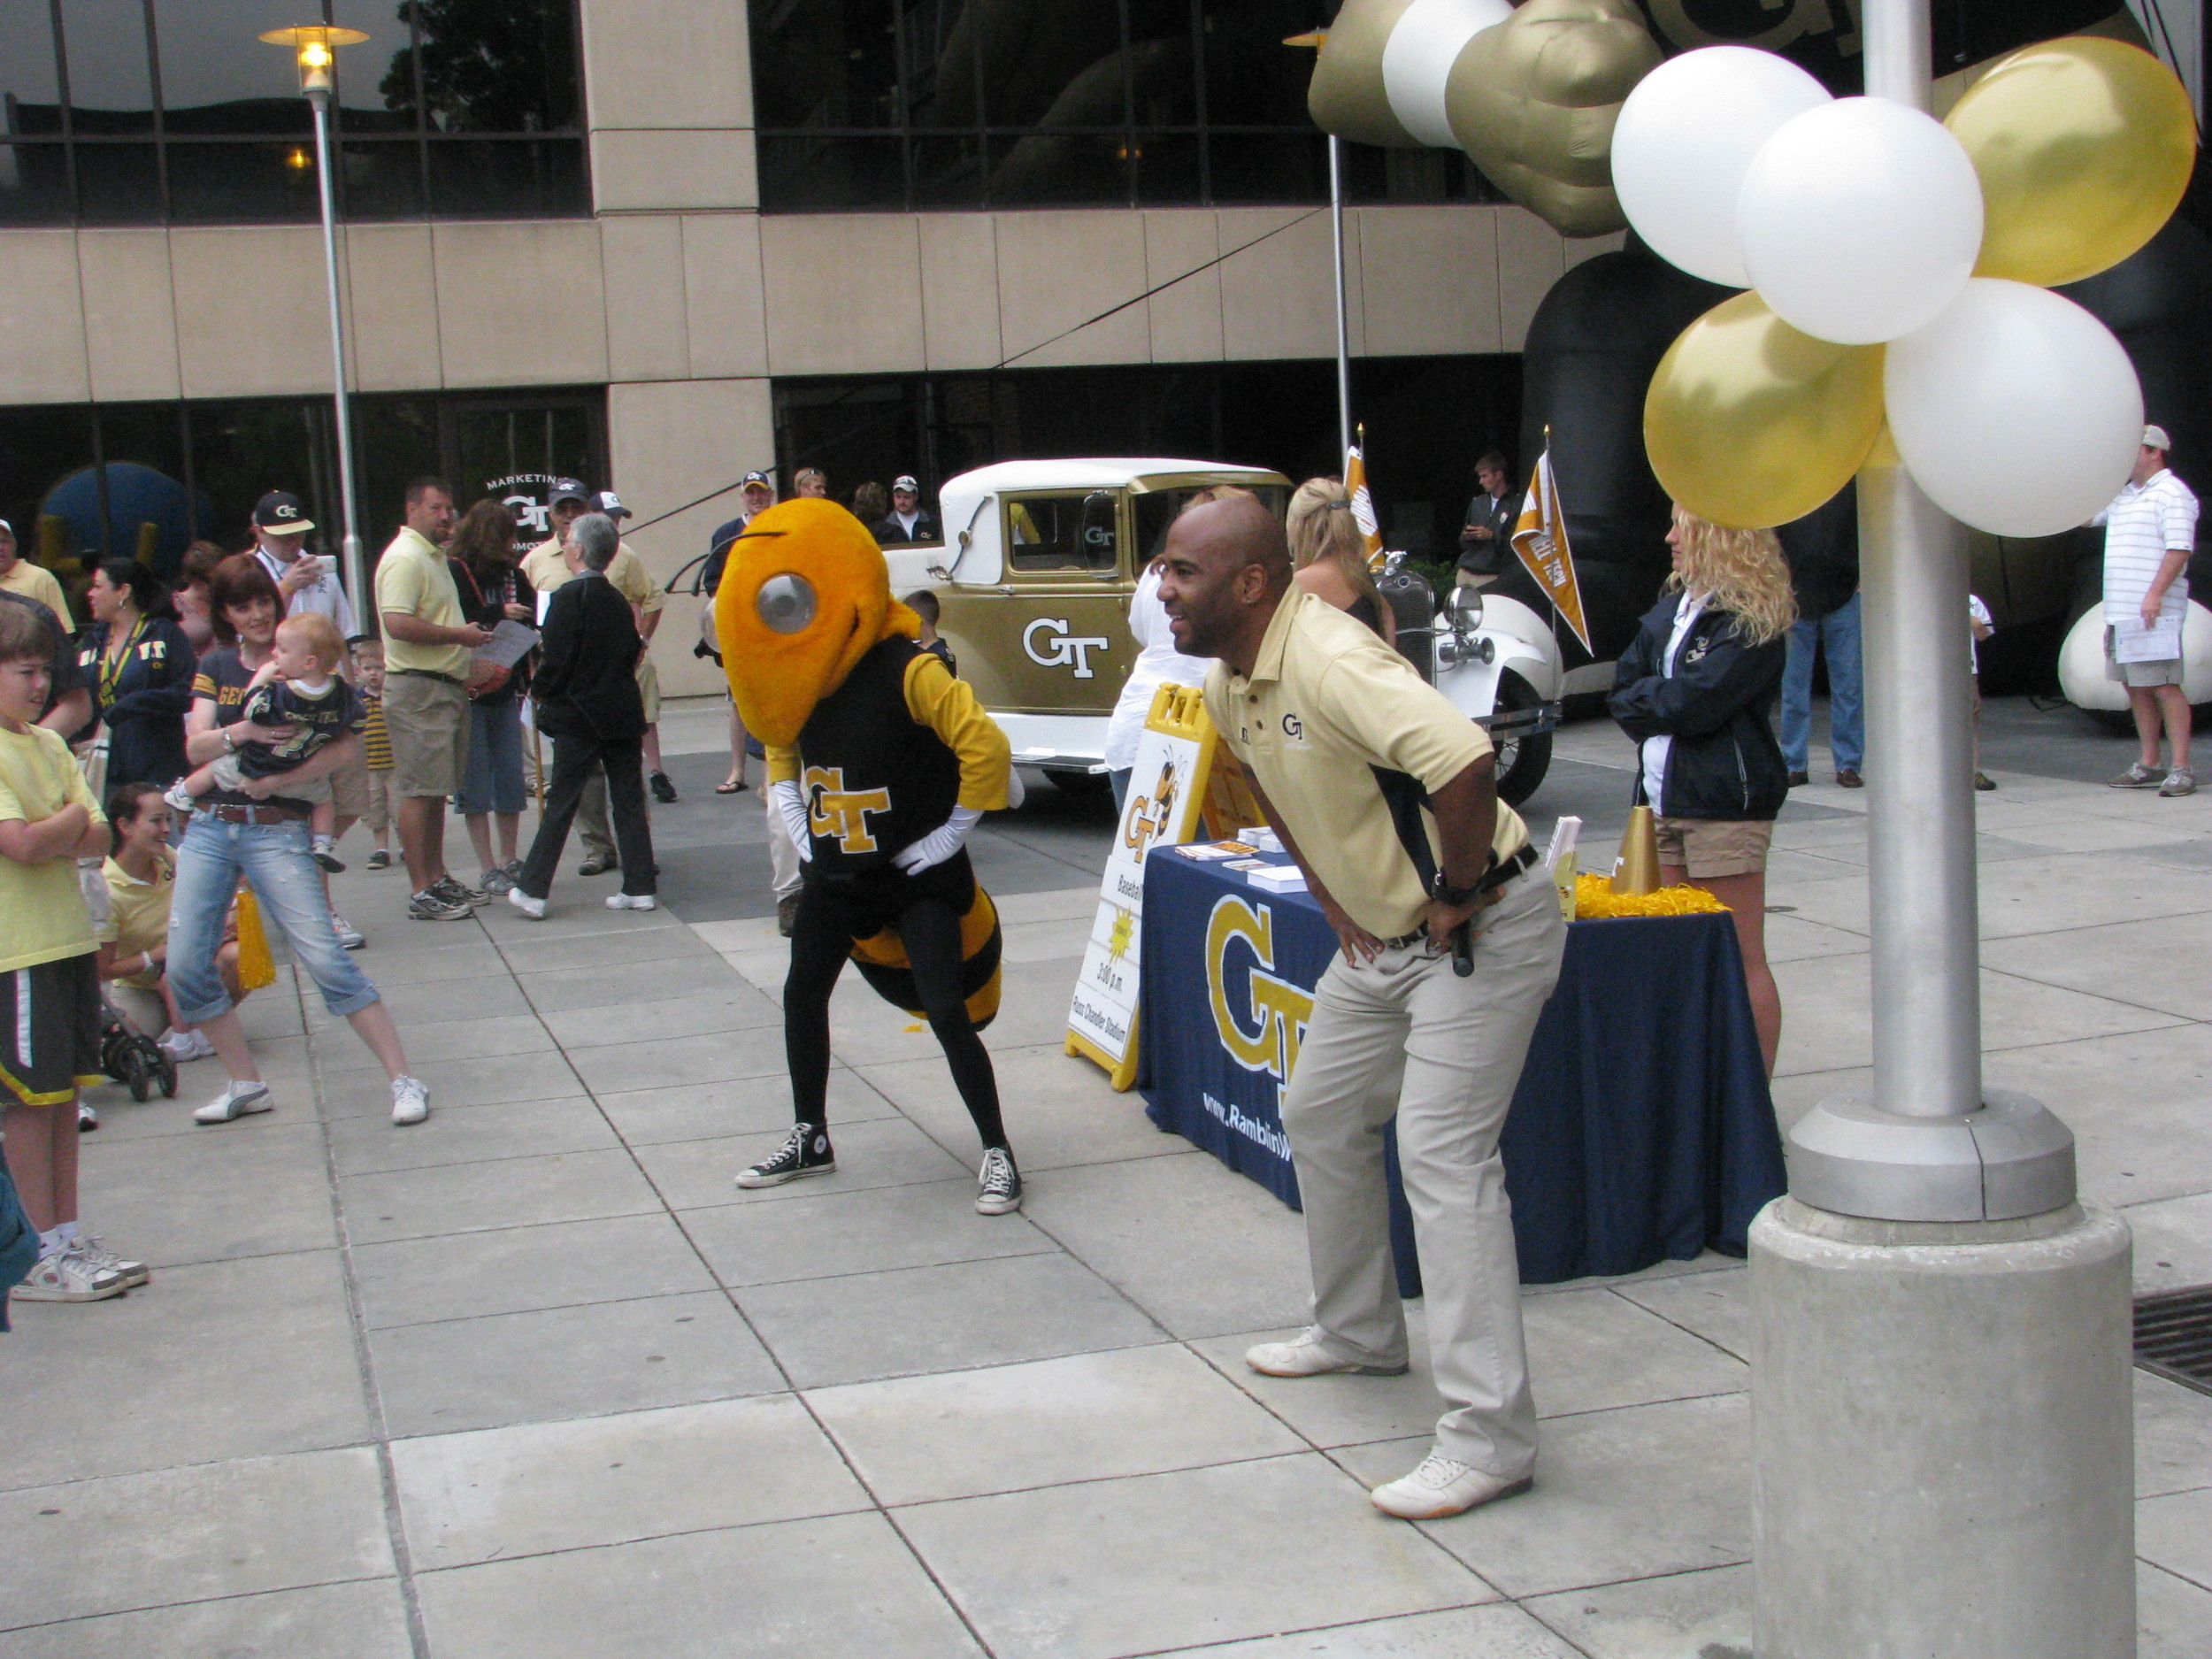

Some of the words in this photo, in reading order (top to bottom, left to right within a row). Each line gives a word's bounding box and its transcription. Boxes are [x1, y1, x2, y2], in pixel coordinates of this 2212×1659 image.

[486, 473, 562, 491] MARKETIN
[276, 504, 297, 518] GT
[1085, 526, 1114, 546] GT
[1023, 618, 1109, 679] GT
[805, 765, 892, 854] GT
[1125, 795, 1156, 864] GT
[1105, 1017, 1126, 1044] Stadium
